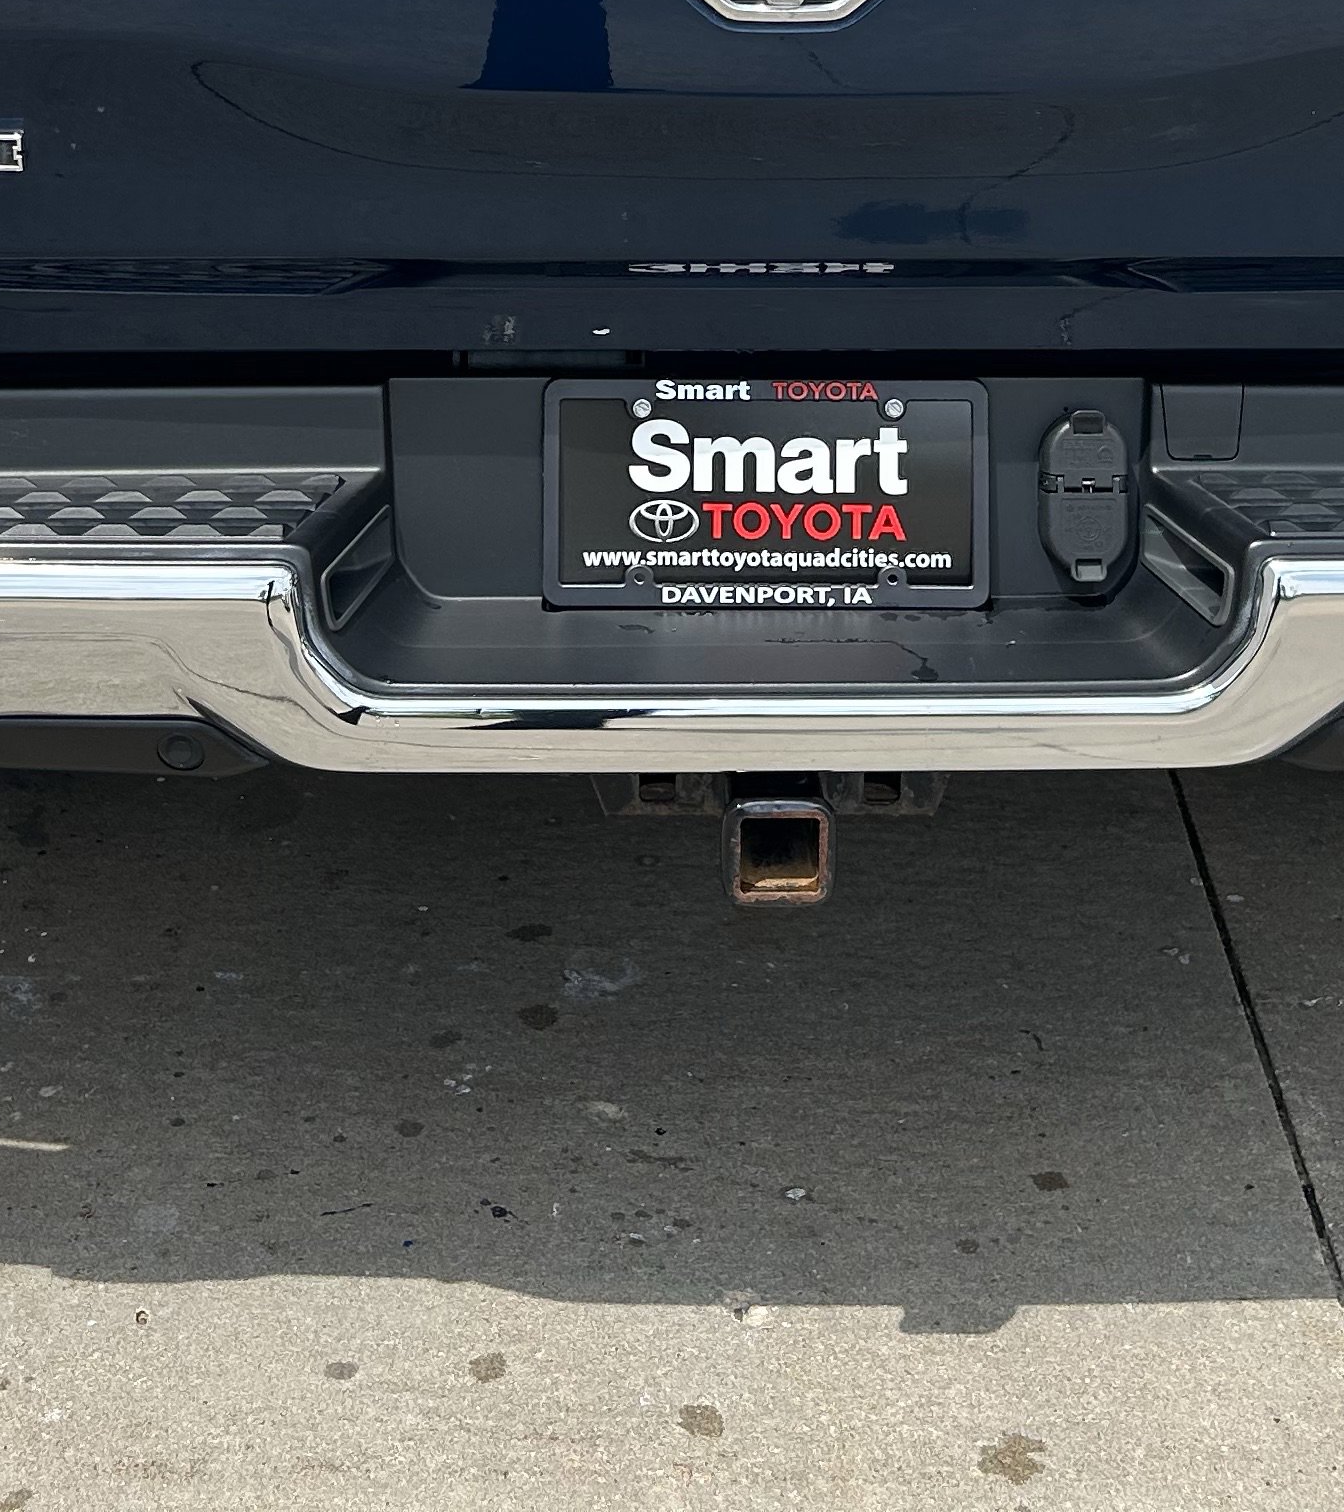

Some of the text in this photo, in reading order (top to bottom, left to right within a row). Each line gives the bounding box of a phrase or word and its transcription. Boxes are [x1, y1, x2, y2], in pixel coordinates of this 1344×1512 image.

[656, 380, 878, 401] Smart TOYOTA
[628, 419, 908, 496] Smart
[702, 502, 908, 541] TOYOTA
[583, 548, 952, 572] www.smarttoyotaquadcities.com
[661, 586, 873, 607] DAVENPORT, IA
